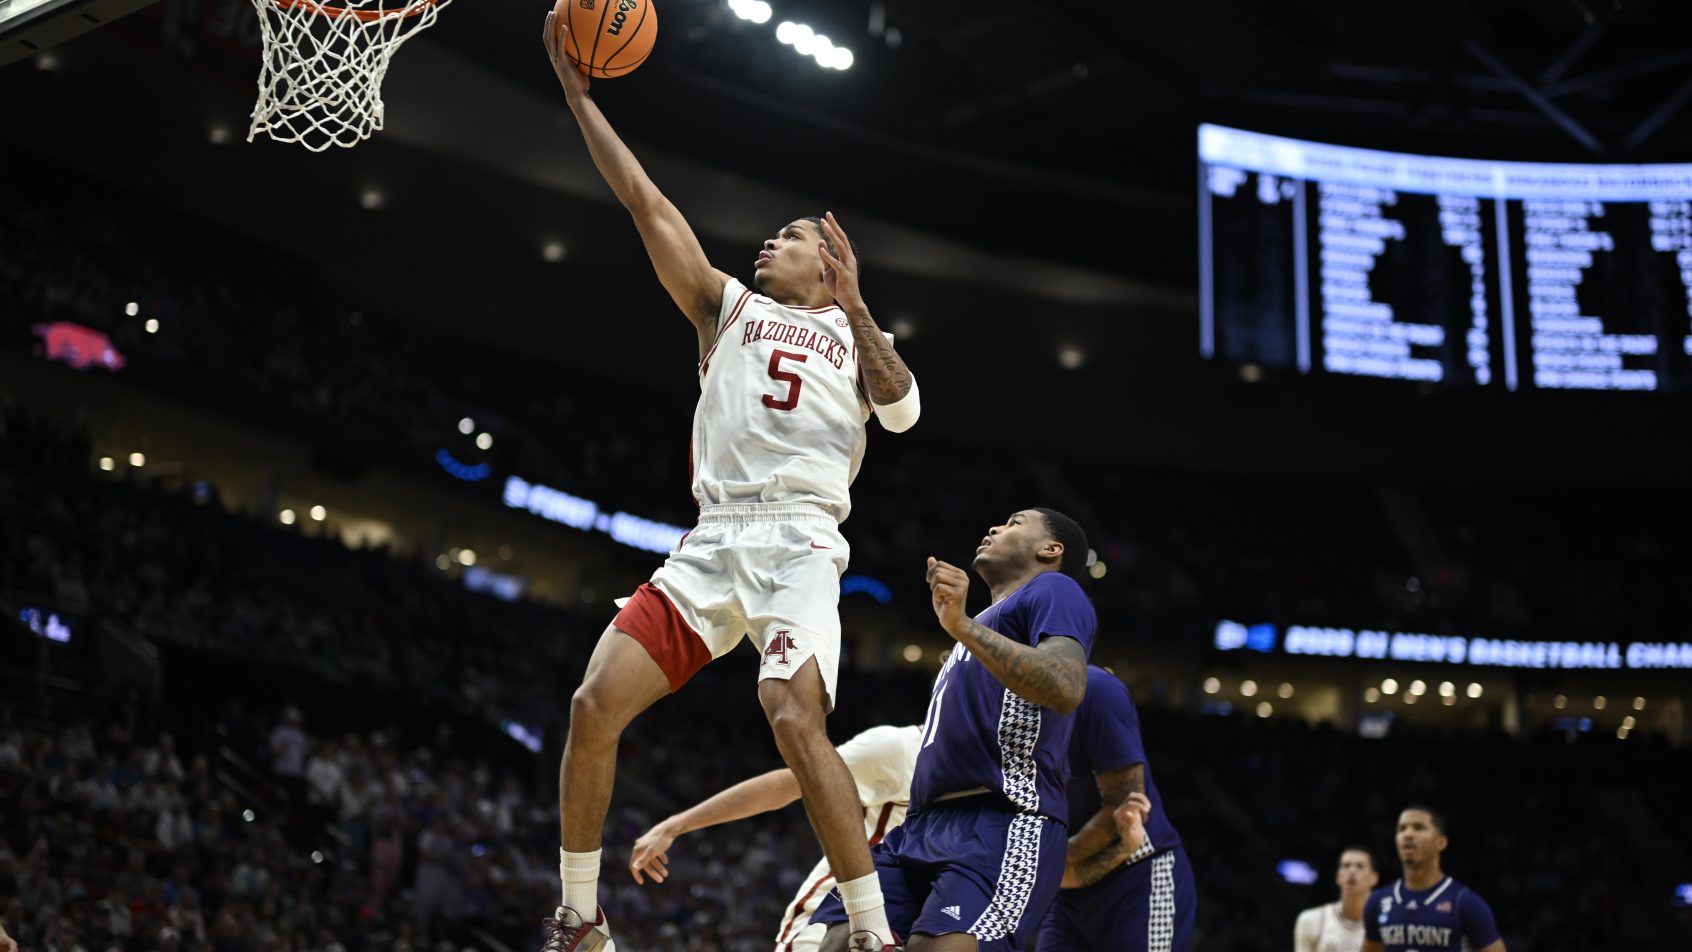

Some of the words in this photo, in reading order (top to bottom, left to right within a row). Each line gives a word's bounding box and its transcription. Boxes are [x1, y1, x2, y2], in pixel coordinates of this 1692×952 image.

[742, 319, 847, 370] RAZORBACKS
[762, 348, 808, 411] 5
[1468, 637, 1622, 668] BASKETBALL
[1407, 924, 1453, 947] POINT
